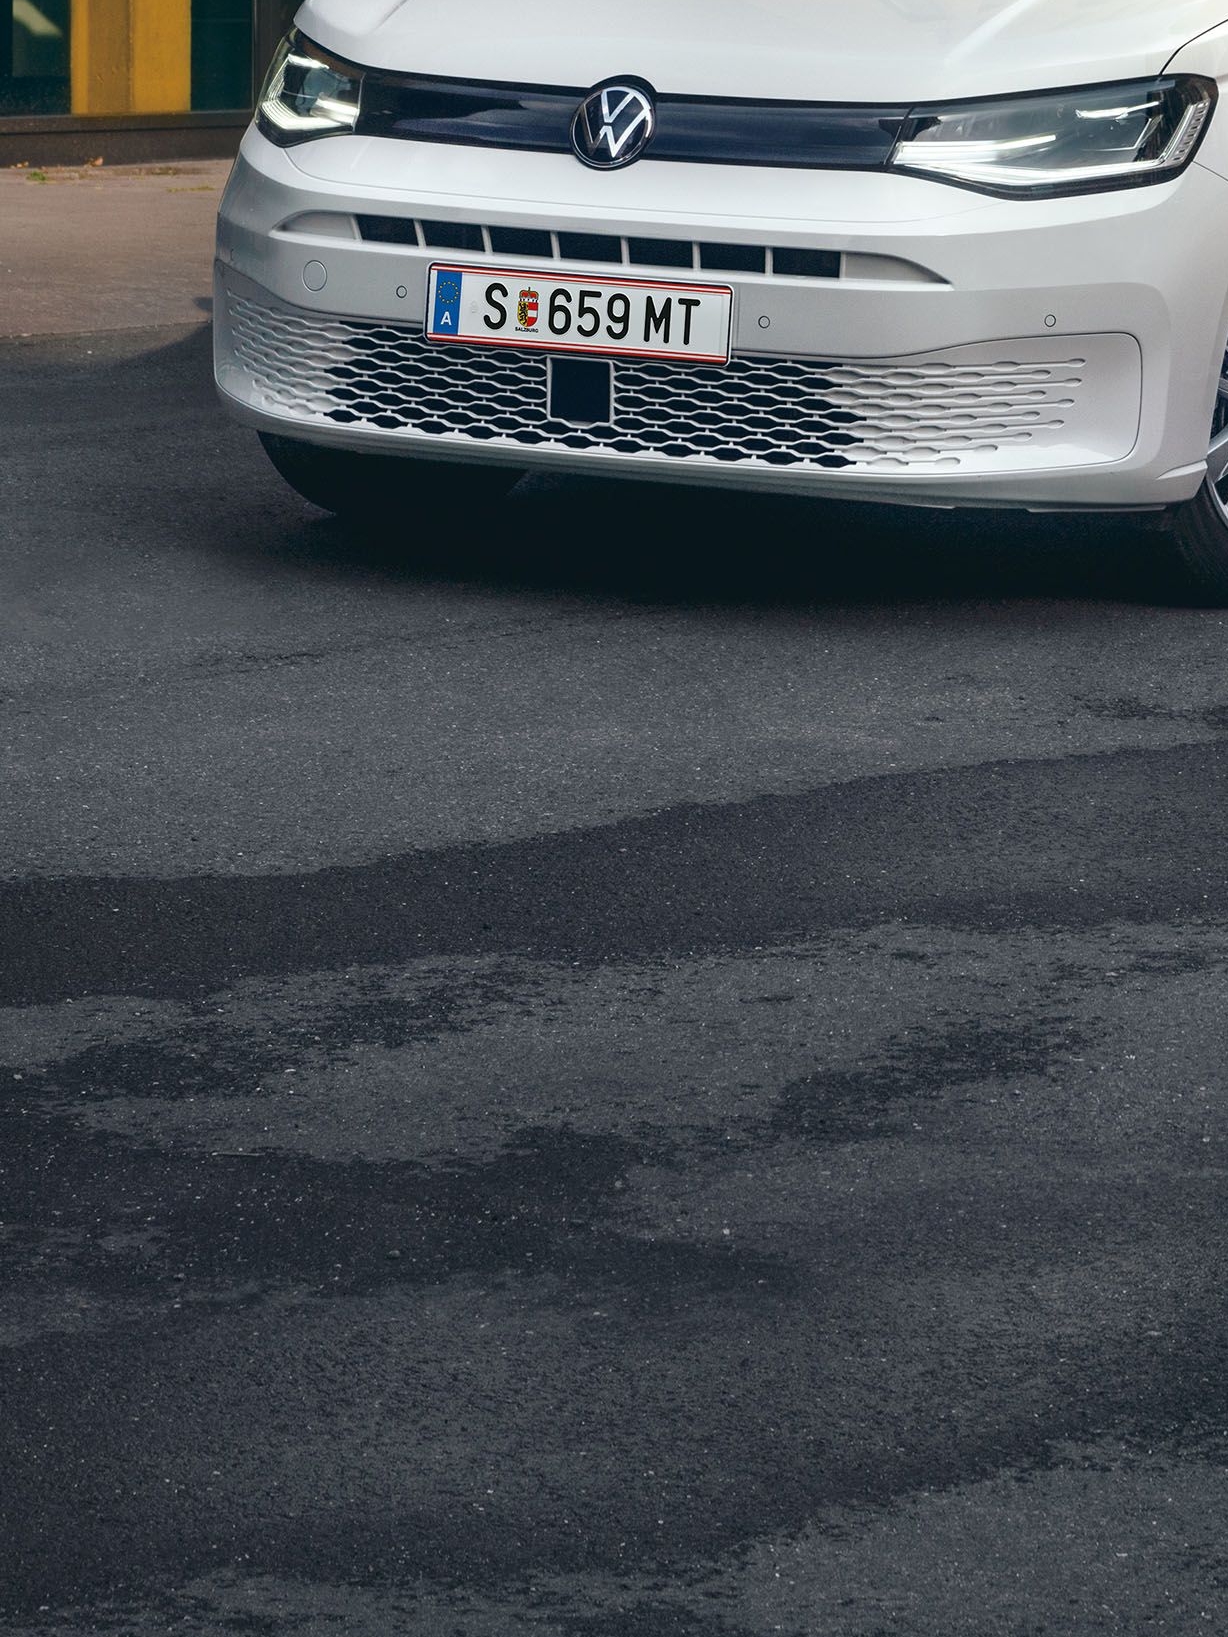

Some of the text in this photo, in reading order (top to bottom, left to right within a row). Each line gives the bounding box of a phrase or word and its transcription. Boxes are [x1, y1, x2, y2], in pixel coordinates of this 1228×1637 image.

[440, 311, 452, 326] A
[483, 282, 701, 346] S 659 MT
